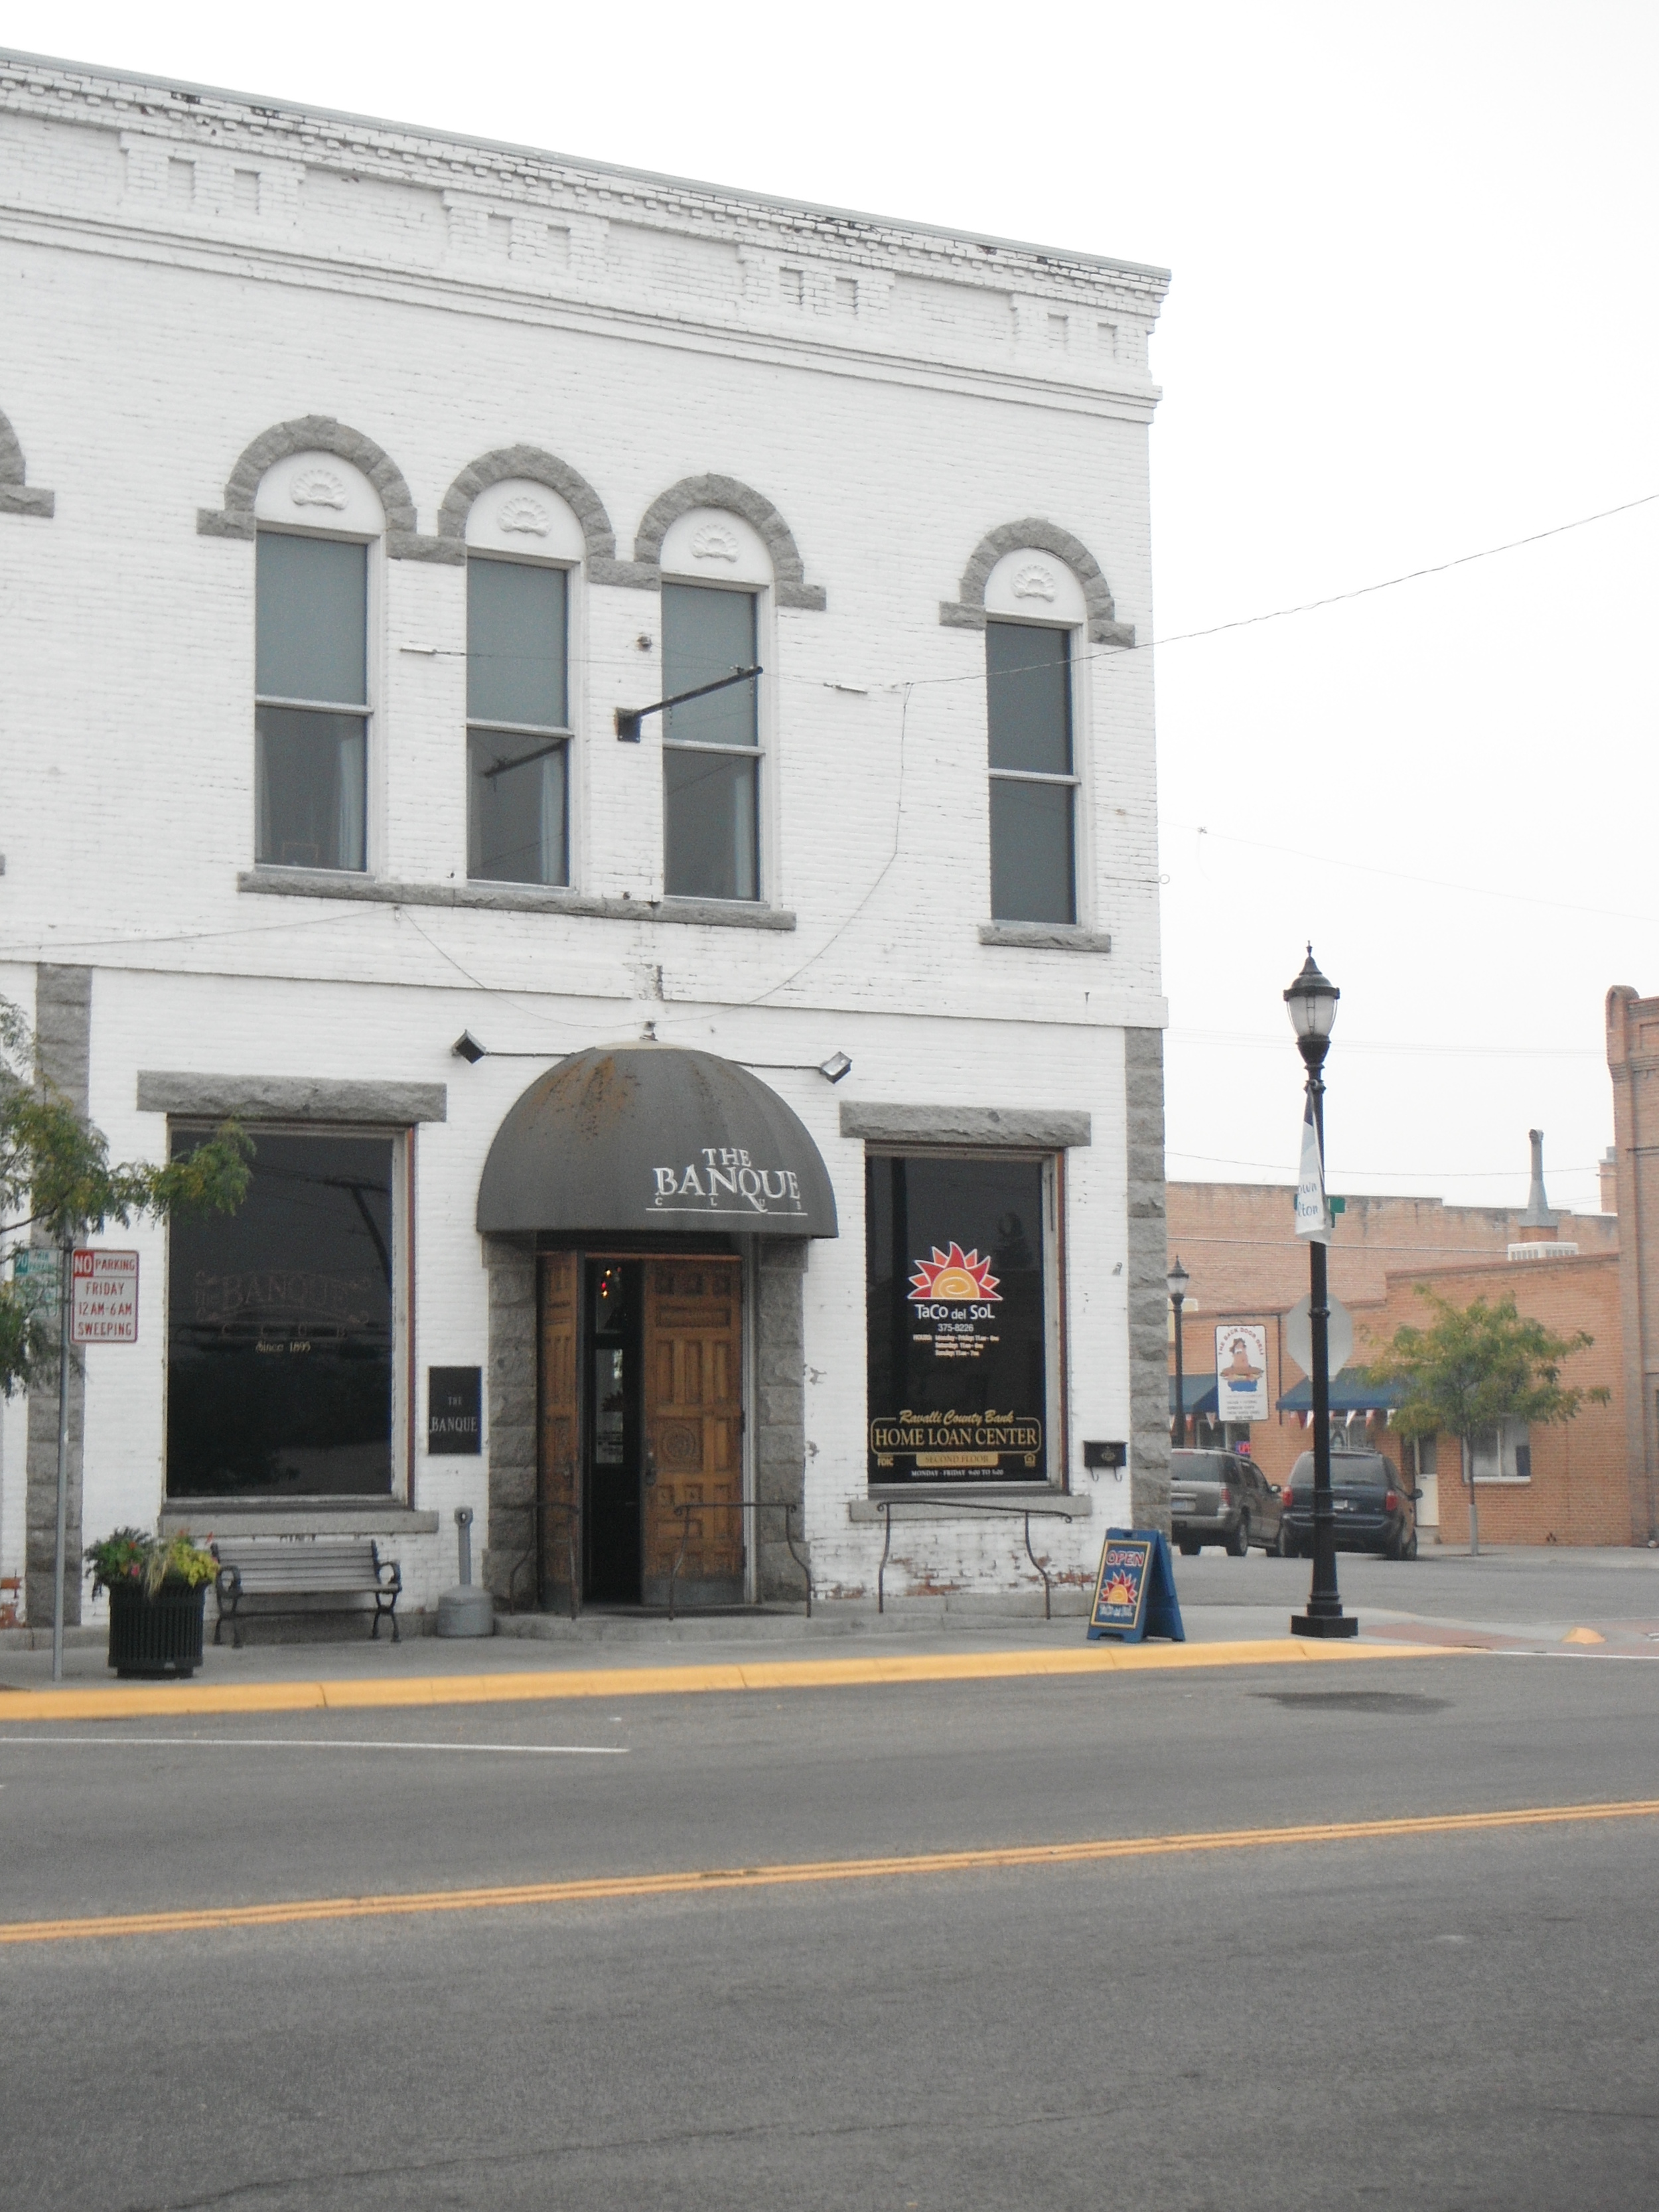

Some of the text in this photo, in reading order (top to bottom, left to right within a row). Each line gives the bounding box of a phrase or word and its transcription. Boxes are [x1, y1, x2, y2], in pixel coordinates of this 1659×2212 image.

[702, 1148, 751, 1167] THE
[653, 1164, 800, 1213] BANQUE
[74, 1255, 135, 1274] NO PARKING
[86, 1282, 125, 1295] FRIDAY
[951, 1309, 967, 1319] del
[78, 1322, 132, 1337] SWEEPING
[938, 1323, 974, 1332] 375-8226
[255, 1341, 284, 1353] Since
[449, 1396, 462, 1405] THE
[431, 1416, 478, 1432] BANQUE
[899, 1410, 1014, 1426] Ravalli County Bank
[875, 1428, 1037, 1445] HOME LOAN CENTER
[925, 1453, 989, 1463] SECOND FLOOR
[1106, 1550, 1145, 1566] OPEN
